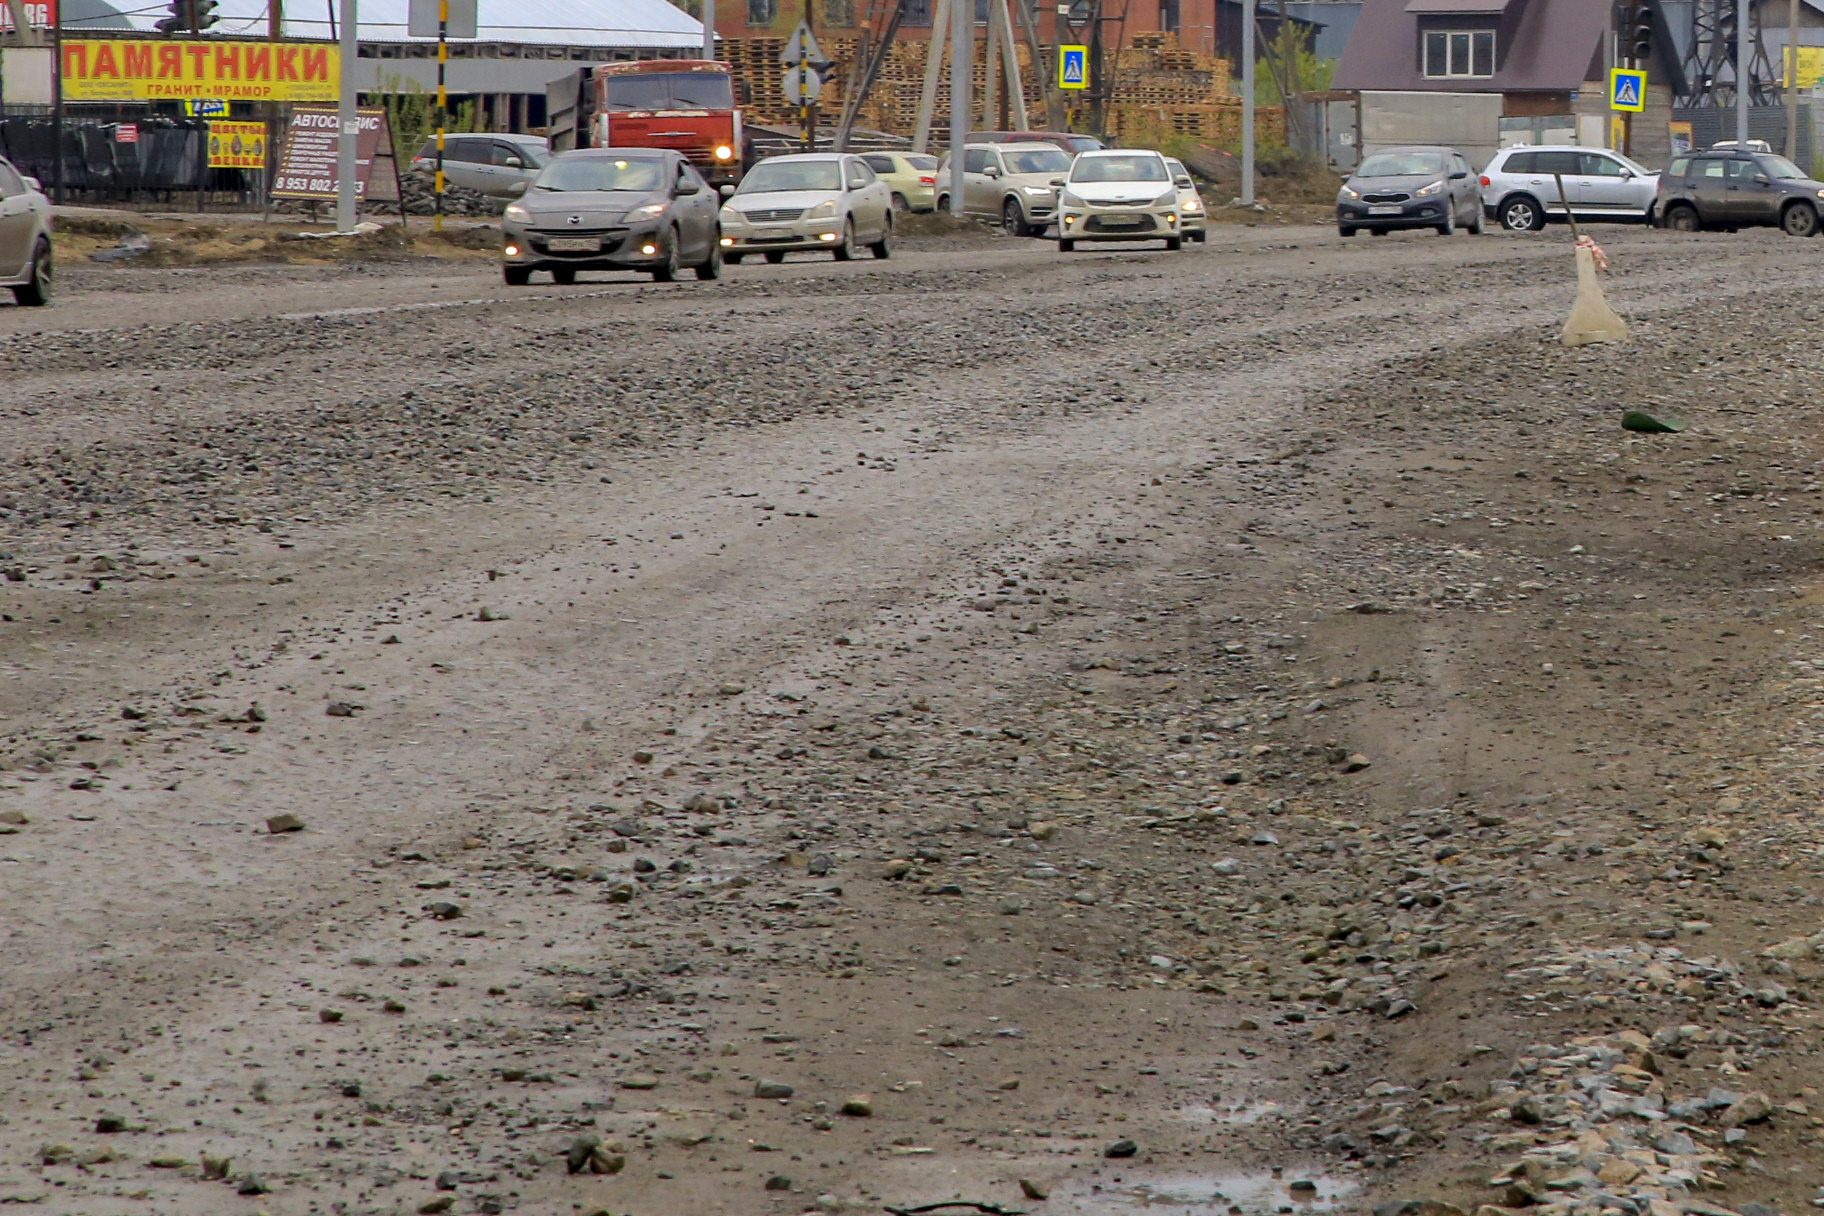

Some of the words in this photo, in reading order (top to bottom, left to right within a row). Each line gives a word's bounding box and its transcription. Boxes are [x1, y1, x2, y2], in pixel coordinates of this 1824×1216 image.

[62, 44, 329, 81] ПАМЯТНИКИ
[146, 85, 202, 97] ГРАНИТ
[213, 86, 272, 97] МРАМОР
[291, 114, 380, 130] АВТОСВИС
[275, 177, 284, 189] 8
[286, 177, 308, 190] 953
[309, 178, 331, 192] 802
